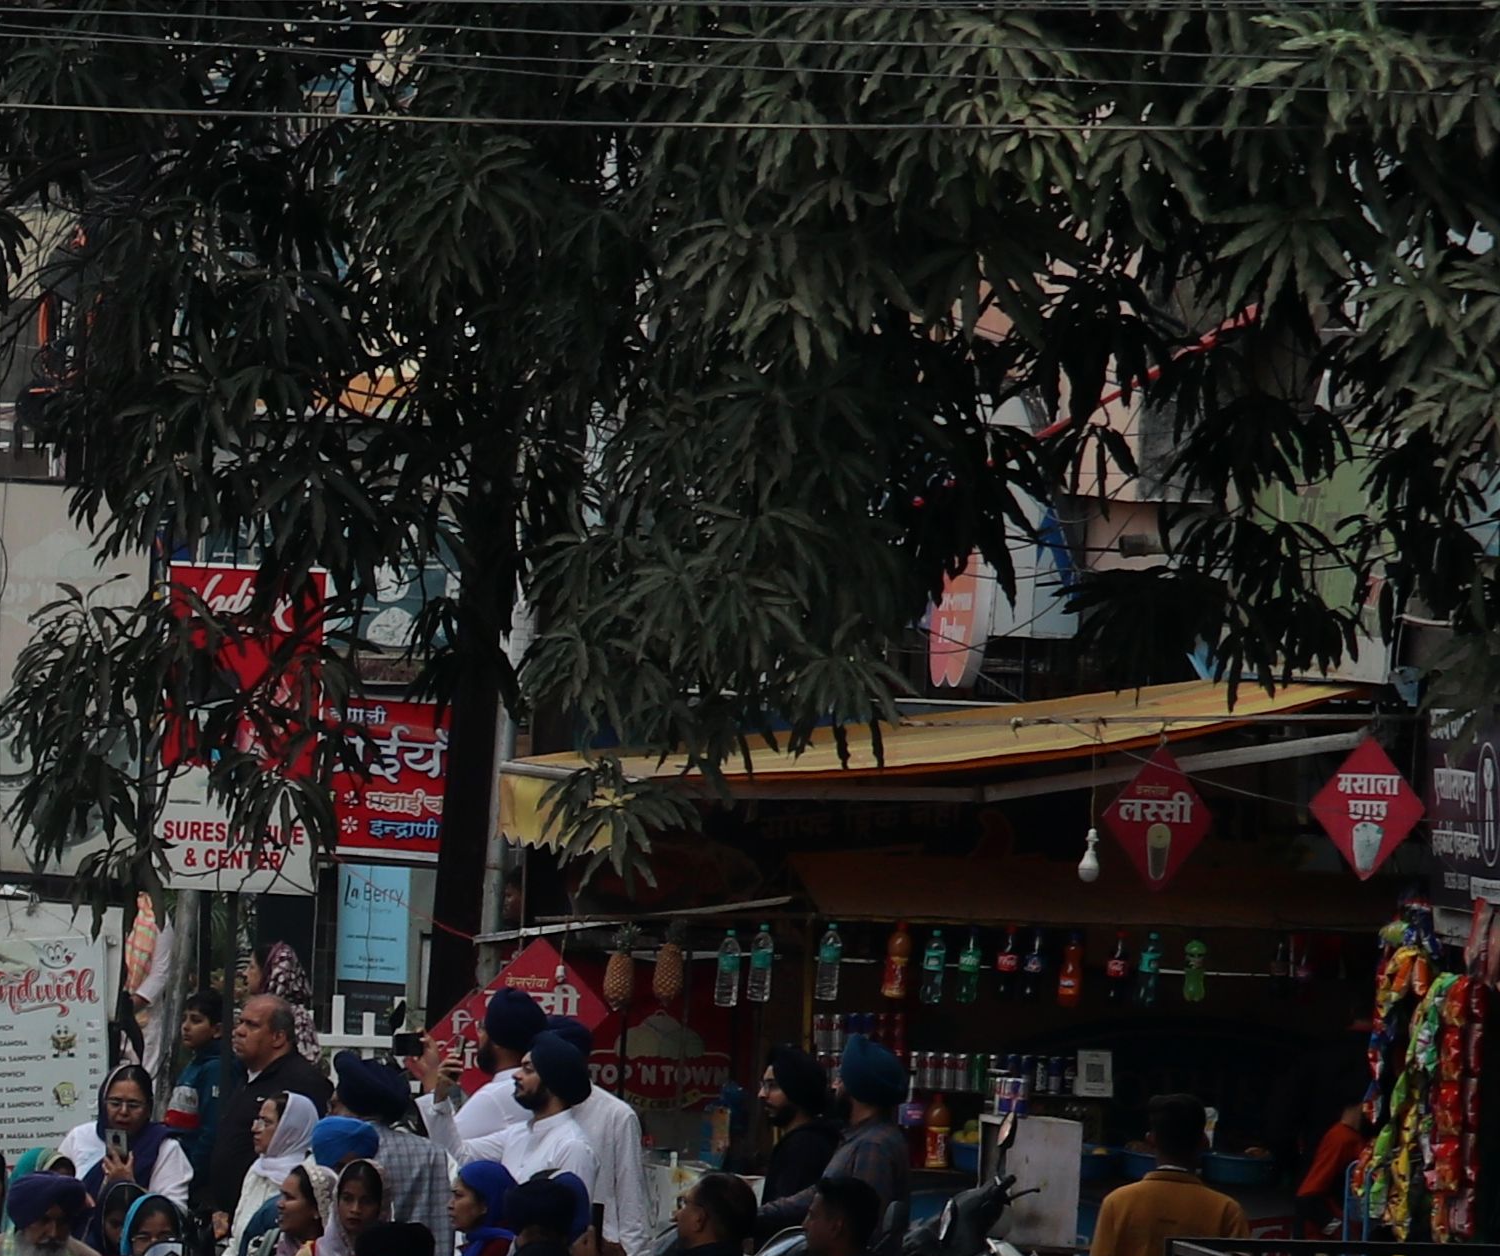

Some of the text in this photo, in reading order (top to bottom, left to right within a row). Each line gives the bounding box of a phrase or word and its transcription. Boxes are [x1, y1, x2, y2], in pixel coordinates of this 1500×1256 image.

[1336, 773, 1401, 796] मसाला
[1118, 791, 1194, 824] लस्सी
[1348, 799, 1388, 821] छाछ
[164, 820, 241, 843] SURES
[184, 848, 197, 867] &
[364, 882, 404, 907] Berry
[589, 1063, 633, 1085] TOP
[660, 1065, 730, 1087] TOWN
[5, 1085, 43, 1093] SANDWICH
[7, 1101, 45, 1109] SANDWICH
